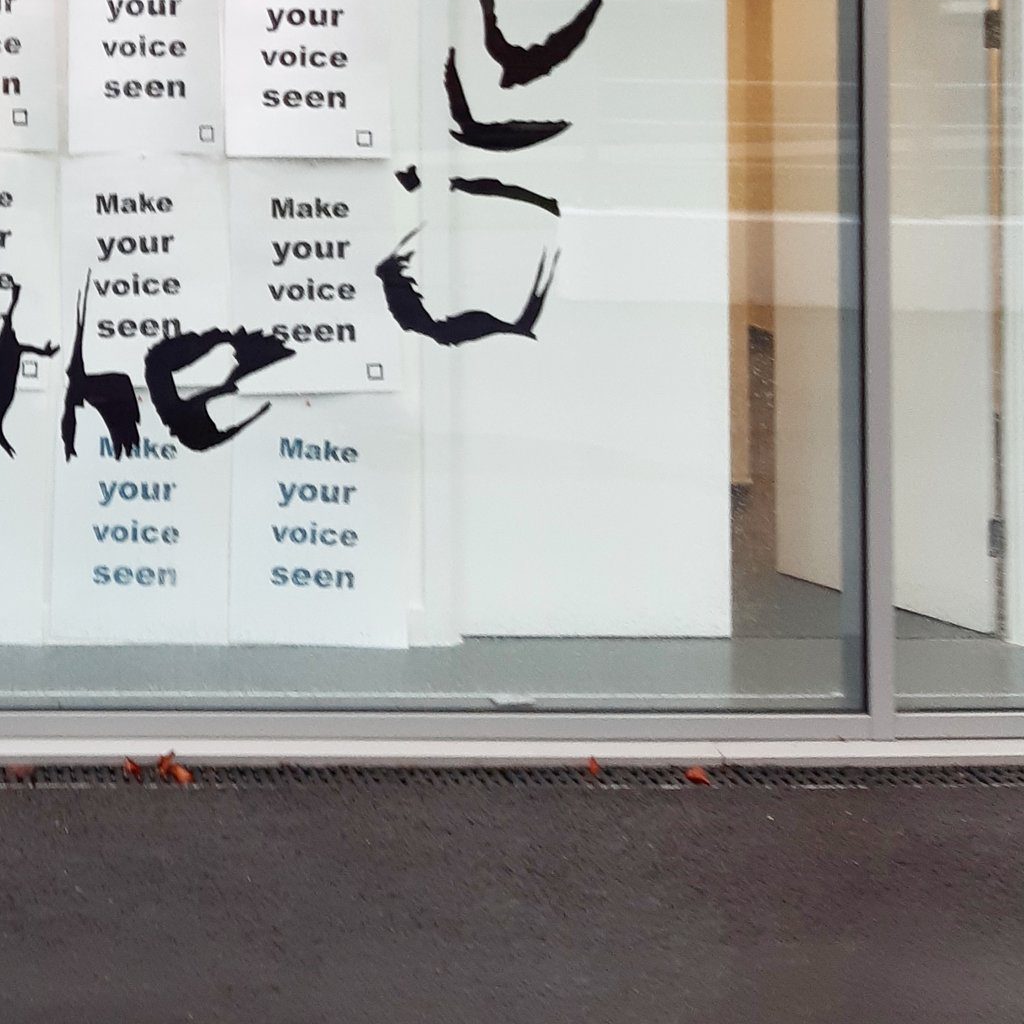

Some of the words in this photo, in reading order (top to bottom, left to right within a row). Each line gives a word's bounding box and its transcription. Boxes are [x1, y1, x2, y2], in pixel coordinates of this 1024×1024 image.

[266, 8, 344, 32] your
[102, 35, 187, 58] voice
[261, 45, 348, 69] voice
[104, 78, 186, 99] seen
[262, 89, 347, 109] seen
[95, 193, 174, 215] Make
[270, 197, 350, 219] Make
[96, 234, 174, 261] your
[271, 239, 351, 266] your
[93, 274, 181, 297] voice
[267, 278, 356, 301] voice
[97, 317, 181, 339] seen
[272, 322, 357, 343] seen
[279, 436, 359, 463] Make
[98, 479, 178, 507] your
[277, 480, 357, 507] your
[92, 519, 180, 545] voice
[271, 522, 359, 547] voice
[92, 563, 178, 587] seen
[270, 565, 356, 589] seen
